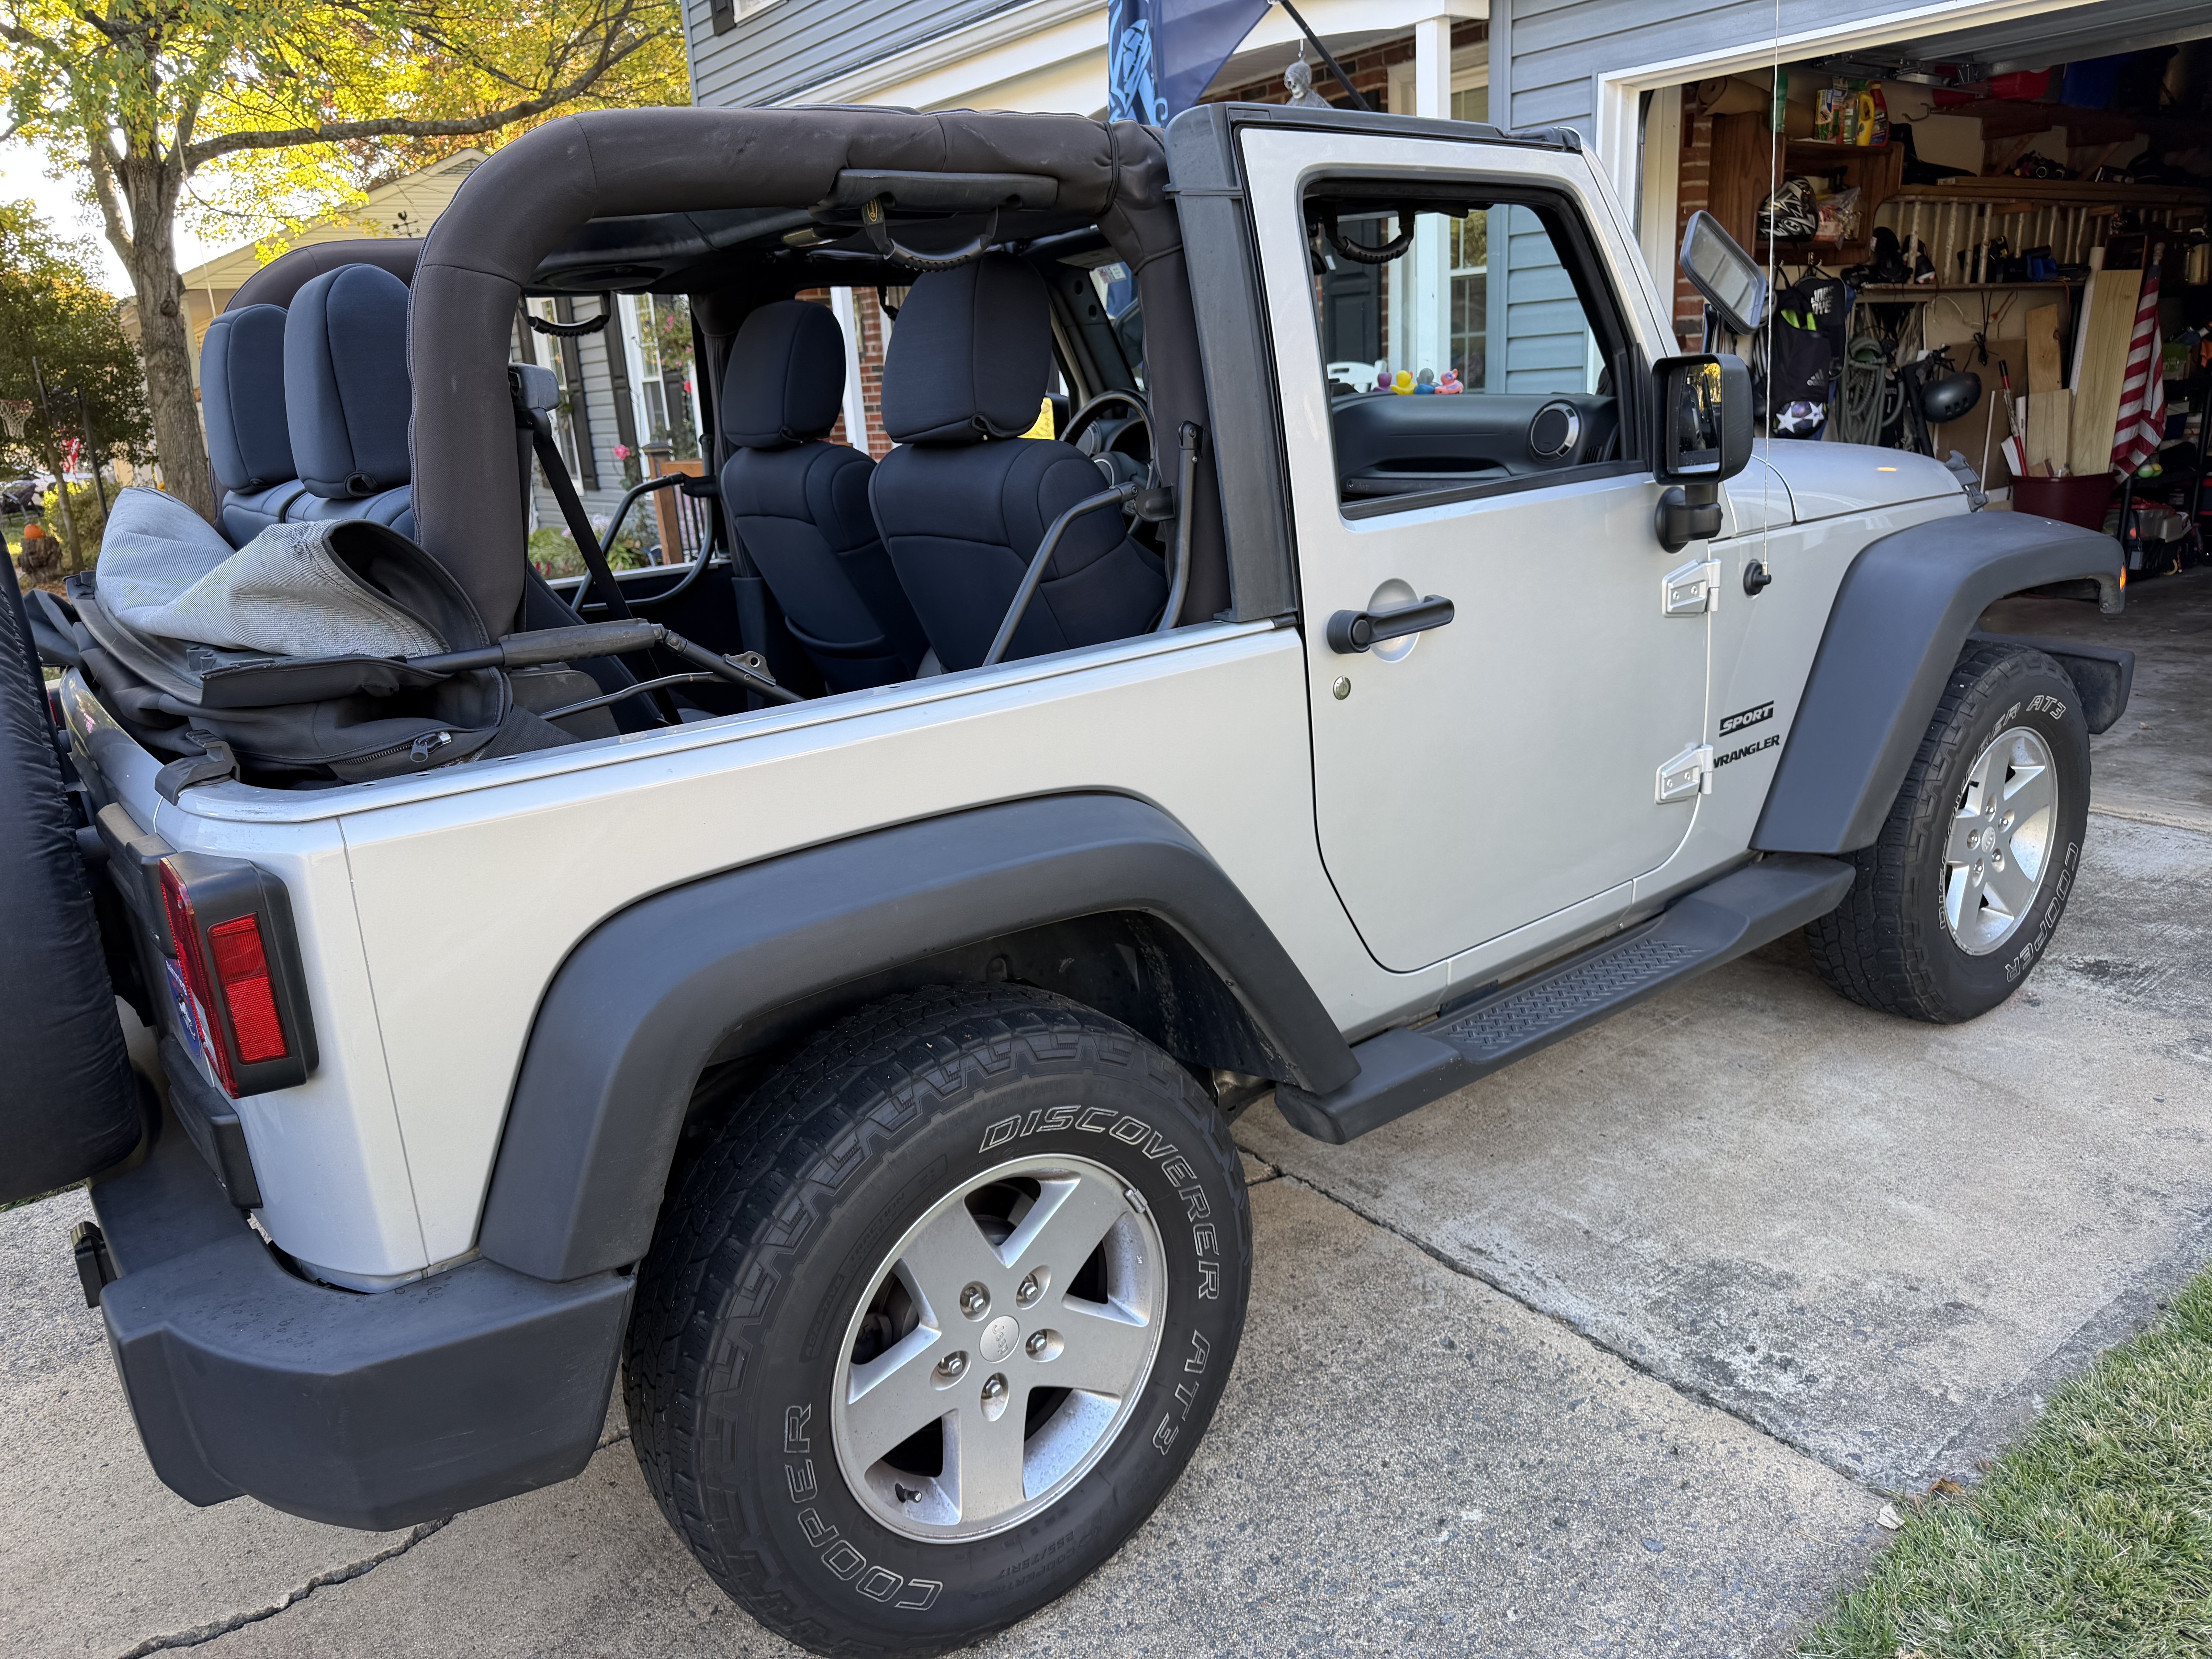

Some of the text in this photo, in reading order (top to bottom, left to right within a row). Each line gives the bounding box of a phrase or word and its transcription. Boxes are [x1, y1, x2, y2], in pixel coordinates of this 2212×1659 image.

[1721, 704, 1774, 733] SPORT
[2026, 694, 2066, 720] AT3
[2004, 842, 2079, 982] COOPER
[978, 1104, 1220, 1300] DISCOVERER
[1152, 1329, 1211, 1456] AT3
[993, 1324, 1009, 1356] Jeep
[784, 1403, 943, 1611] COOPER
